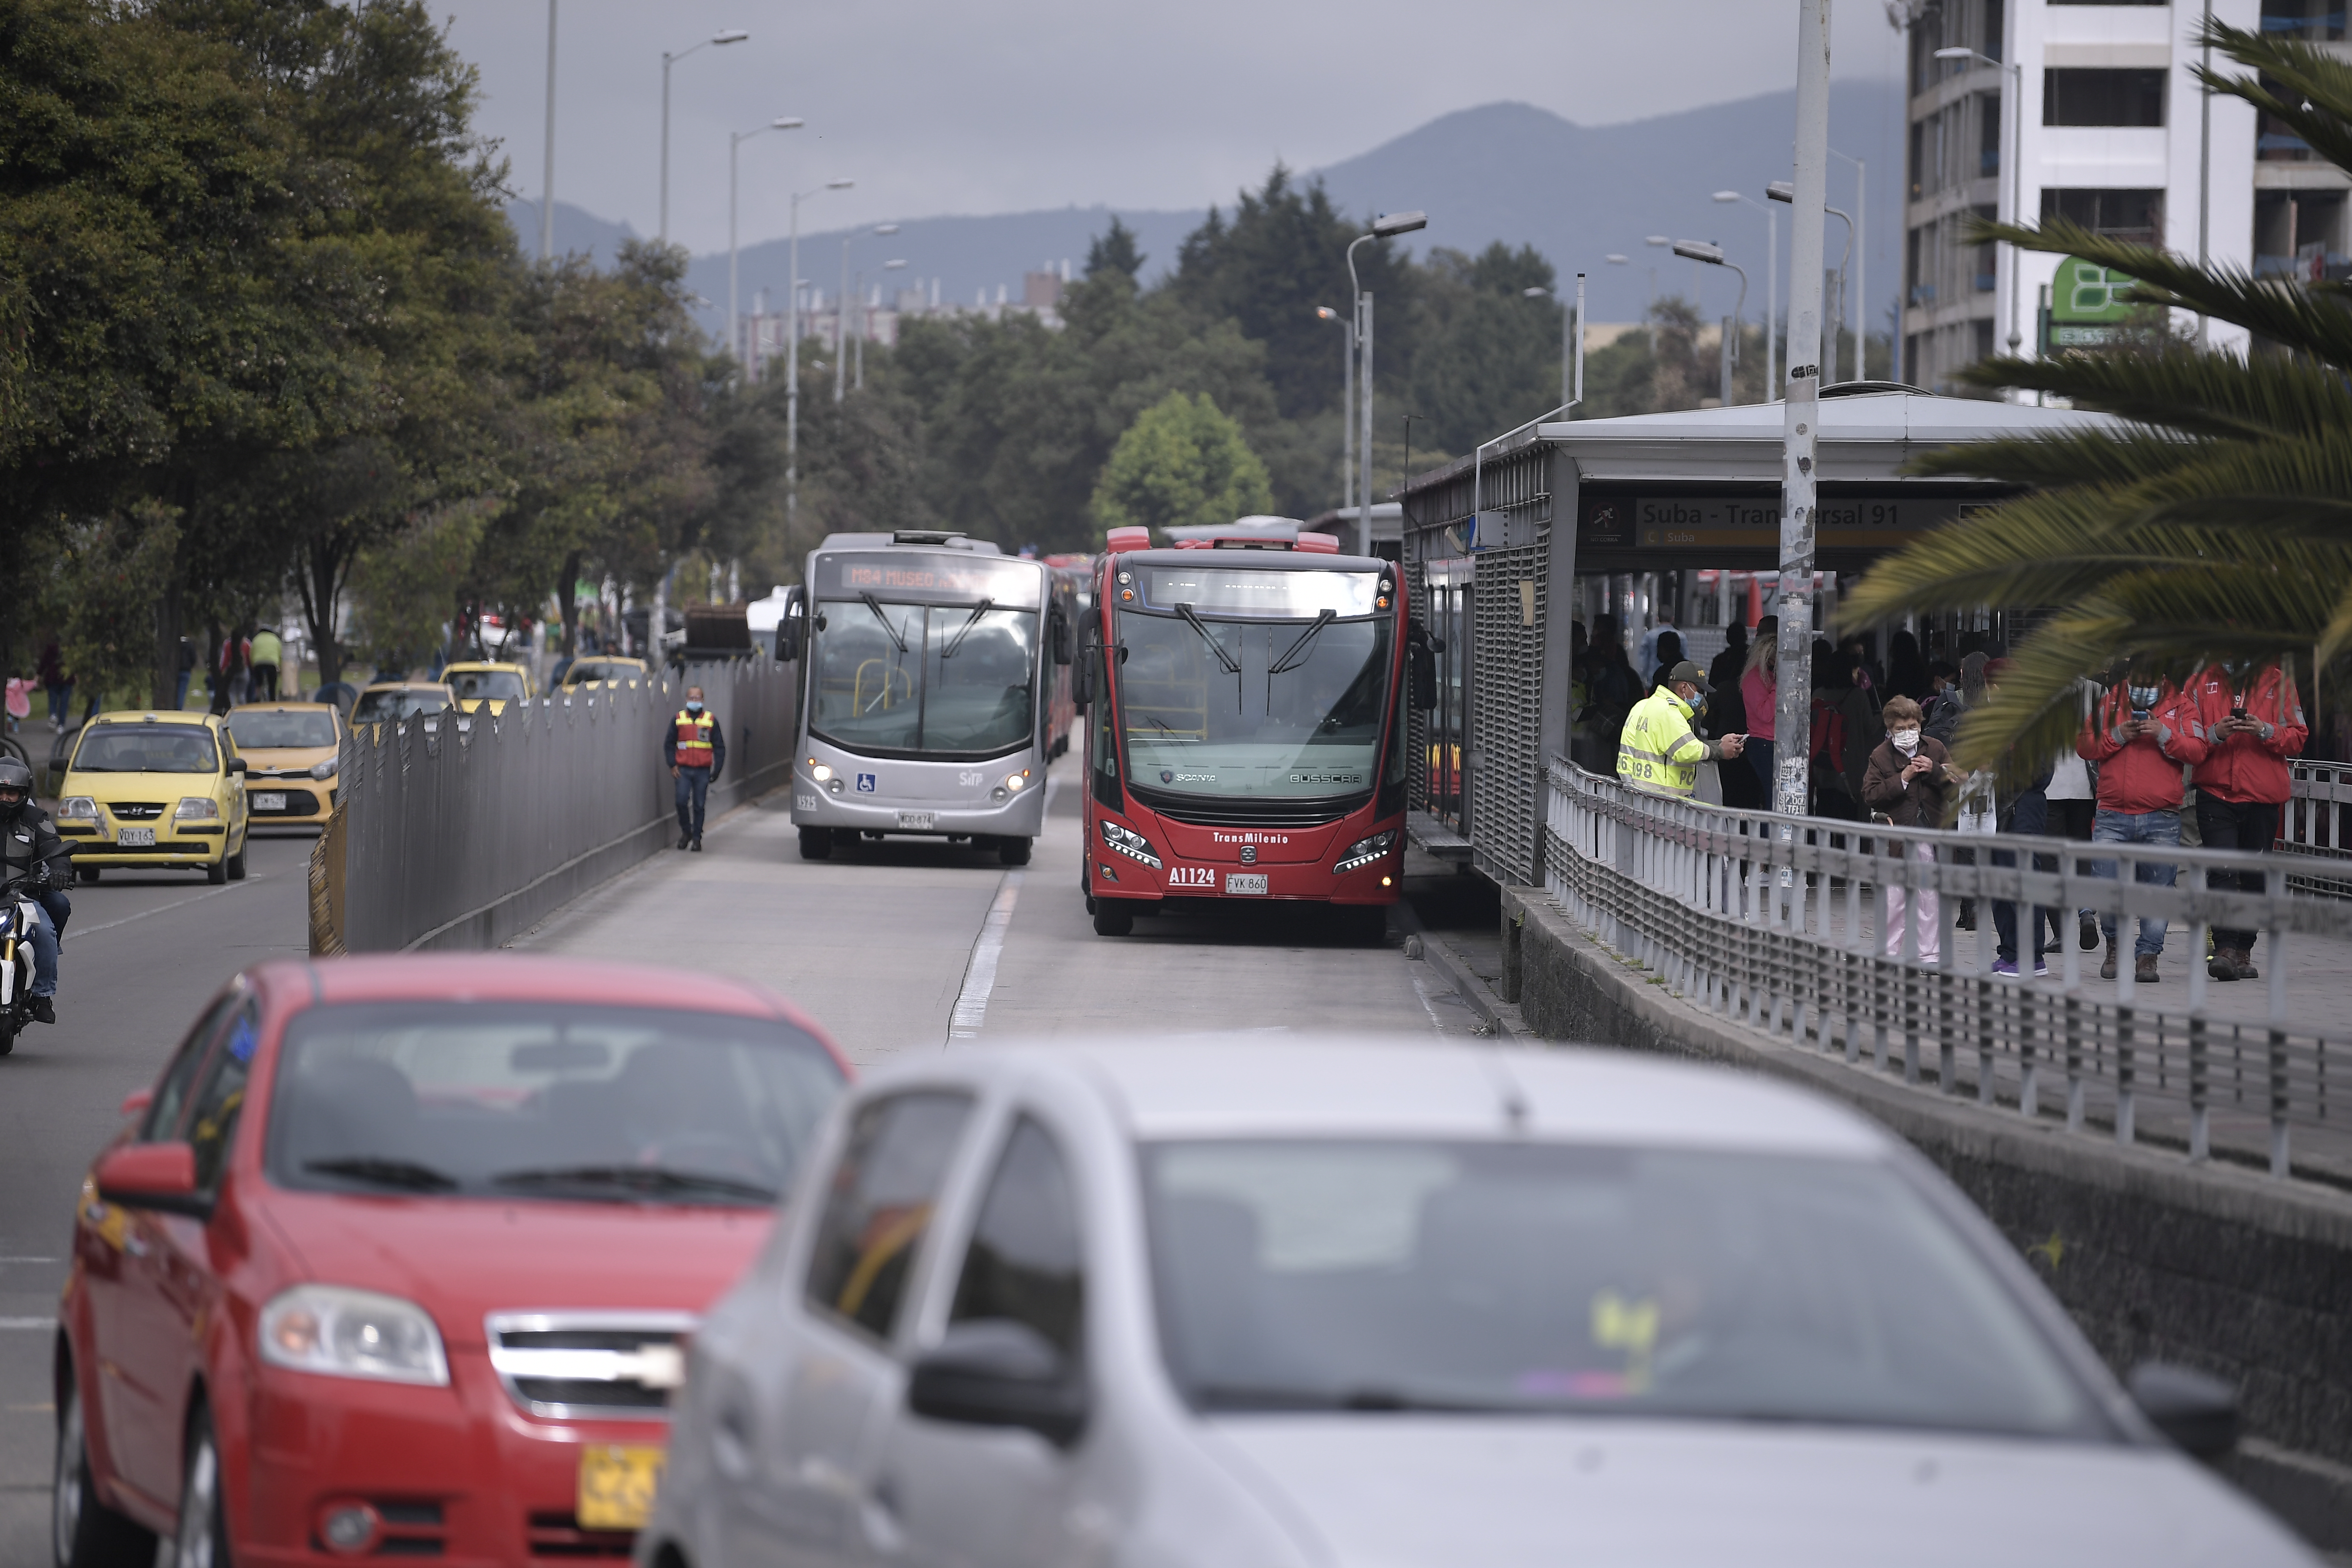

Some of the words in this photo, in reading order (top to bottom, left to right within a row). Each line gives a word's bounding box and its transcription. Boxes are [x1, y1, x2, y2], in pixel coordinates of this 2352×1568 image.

[1644, 503, 1701, 524] Suba
[1872, 504, 1897, 524] 91
[1648, 532, 1655, 542] C
[1668, 532, 1695, 542] Suba
[886, 570, 934, 586] MUSEO
[1176, 773, 1217, 782] SCANIA
[1290, 774, 1362, 784] BUSSCAR
[1213, 832, 1288, 844] TransMilenio
[1169, 867, 1215, 884] A1124
[1228, 878, 1245, 889] FVK
[1249, 878, 1266, 889] 860
